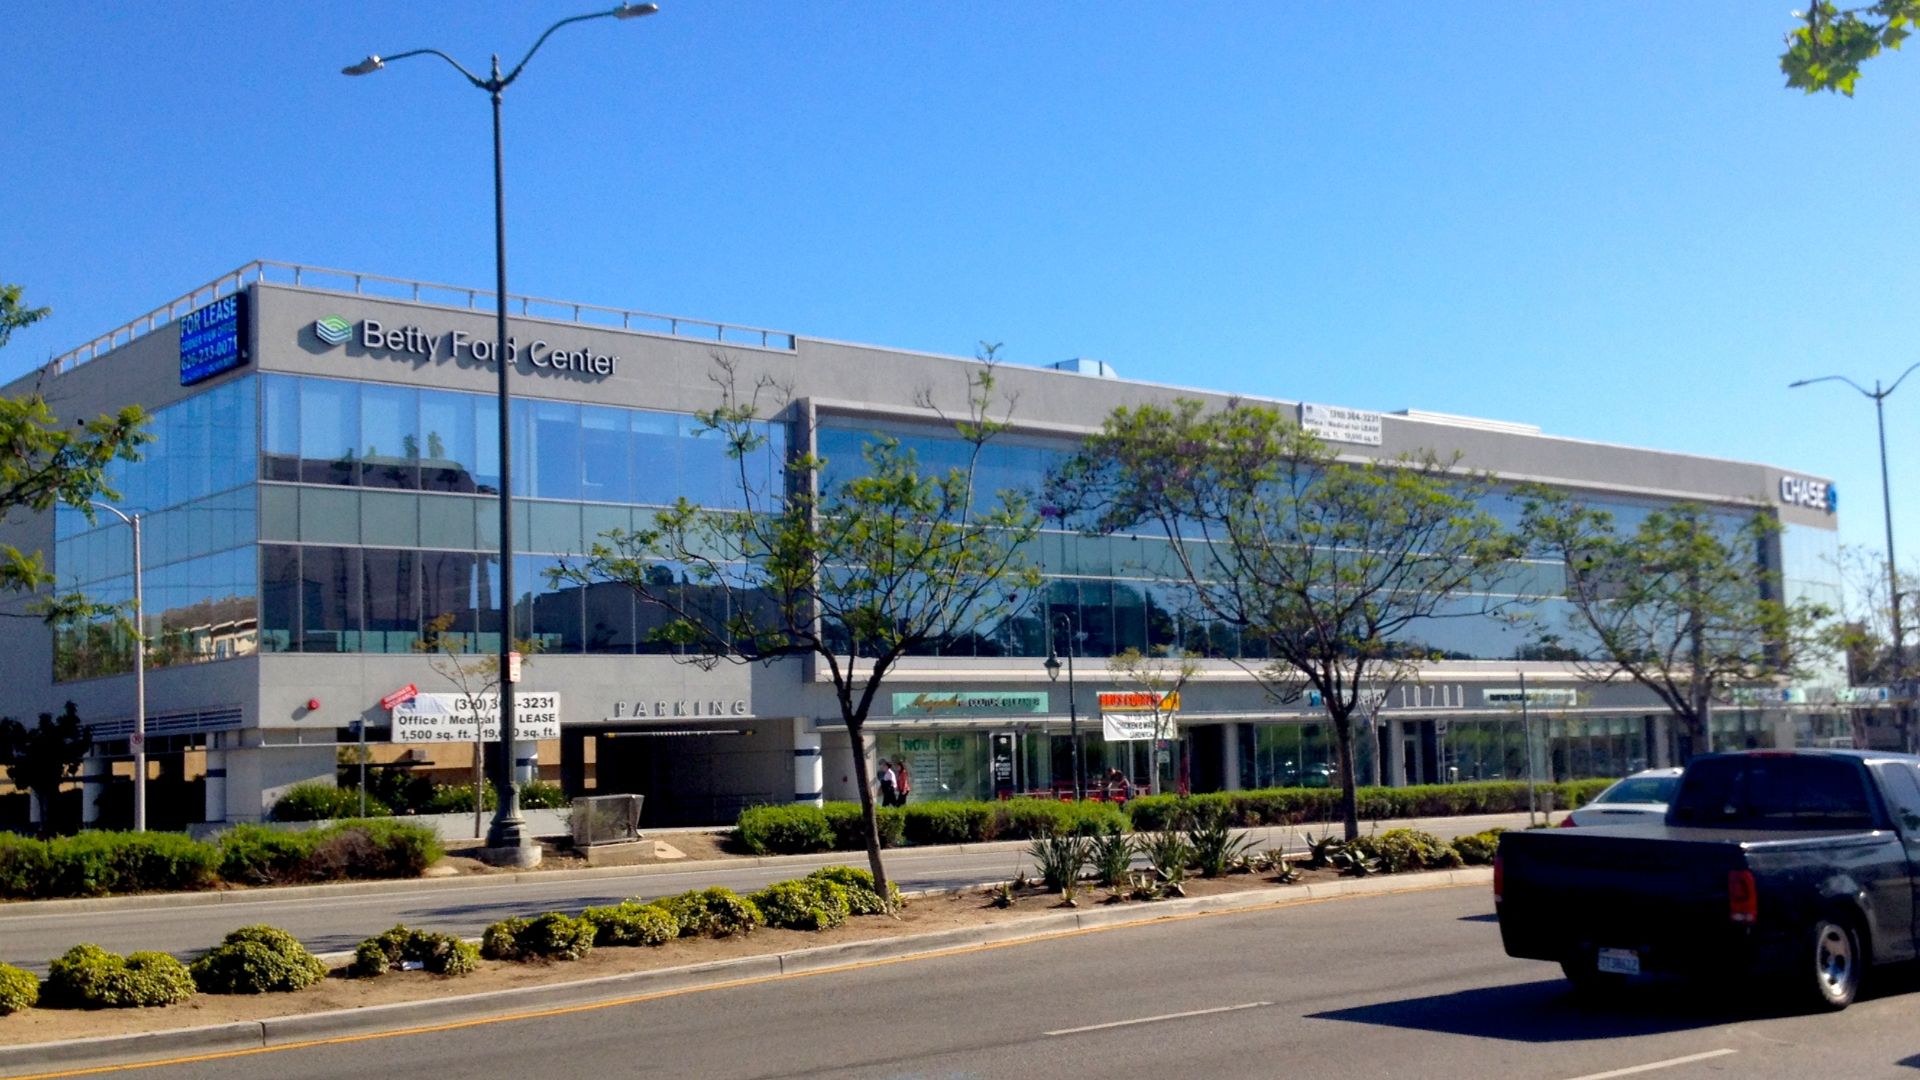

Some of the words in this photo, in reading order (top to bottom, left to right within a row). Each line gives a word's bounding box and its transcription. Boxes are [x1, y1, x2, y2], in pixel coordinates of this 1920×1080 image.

[181, 312, 201, 338] FOR
[203, 296, 237, 328] LEASE
[363, 319, 441, 361] Betty
[530, 340, 621, 375] Center
[1781, 476, 1827, 508] CHASE
[455, 698, 487, 710] (310)
[490, 697, 554, 710] 3-3231
[1401, 684, 1464, 708] 10700
[618, 699, 747, 717] PARKING
[398, 715, 438, 726] Office
[519, 713, 556, 724] LEASE
[401, 730, 432, 742] 1,500
[436, 731, 454, 741] sq.
[457, 729, 471, 739] ft.
[483, 730, 519, 740] 19,0
[523, 728, 540, 738] sq.
[543, 727, 557, 737] ft.
[903, 739, 930, 751] NOW
